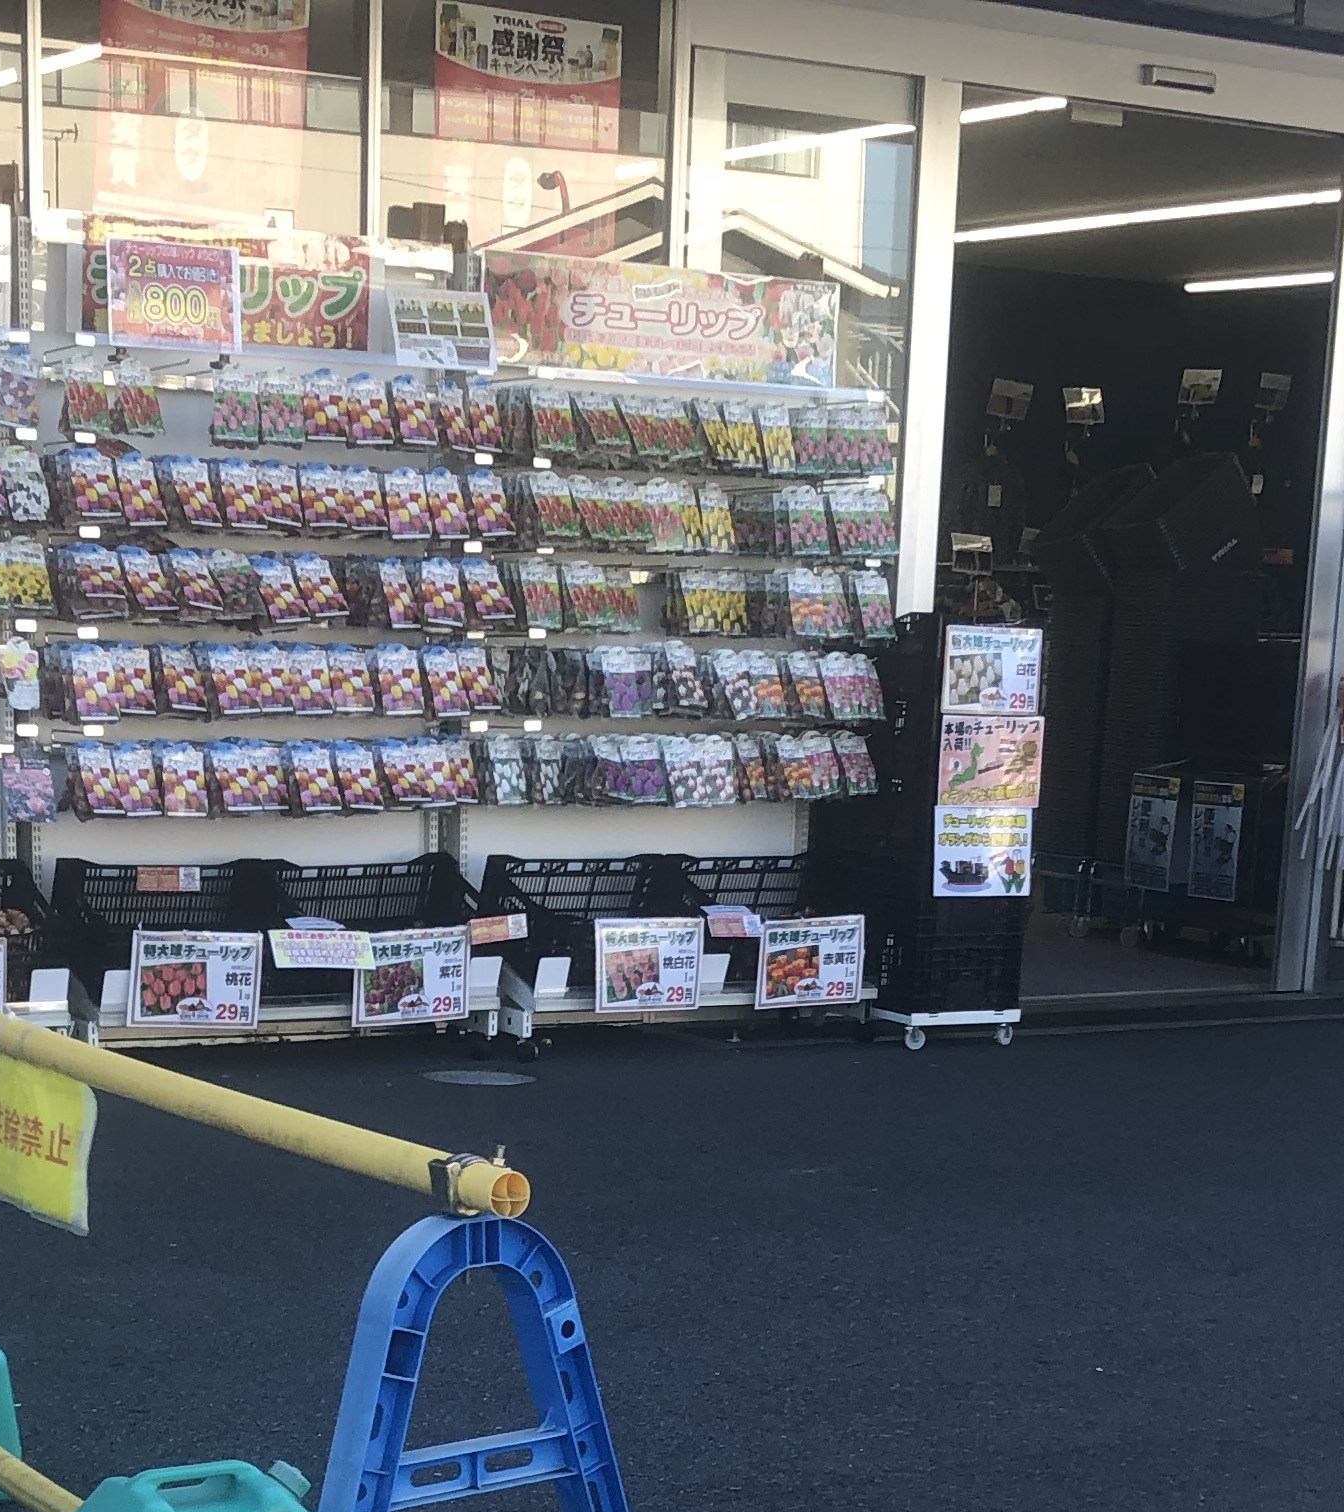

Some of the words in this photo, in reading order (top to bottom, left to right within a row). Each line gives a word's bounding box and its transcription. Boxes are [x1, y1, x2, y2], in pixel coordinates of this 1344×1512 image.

[492, 14, 534, 29] TRIAL
[491, 27, 566, 65] 感謝祭
[571, 292, 766, 341] チューリップ
[1015, 662, 1037, 677] 白花
[943, 719, 1041, 737] 本場のチューリップ
[662, 955, 696, 971] 桃白花
[822, 951, 857, 967] 赤黄花
[224, 971, 253, 987] 桃花
[438, 963, 463, 980] 紫花
